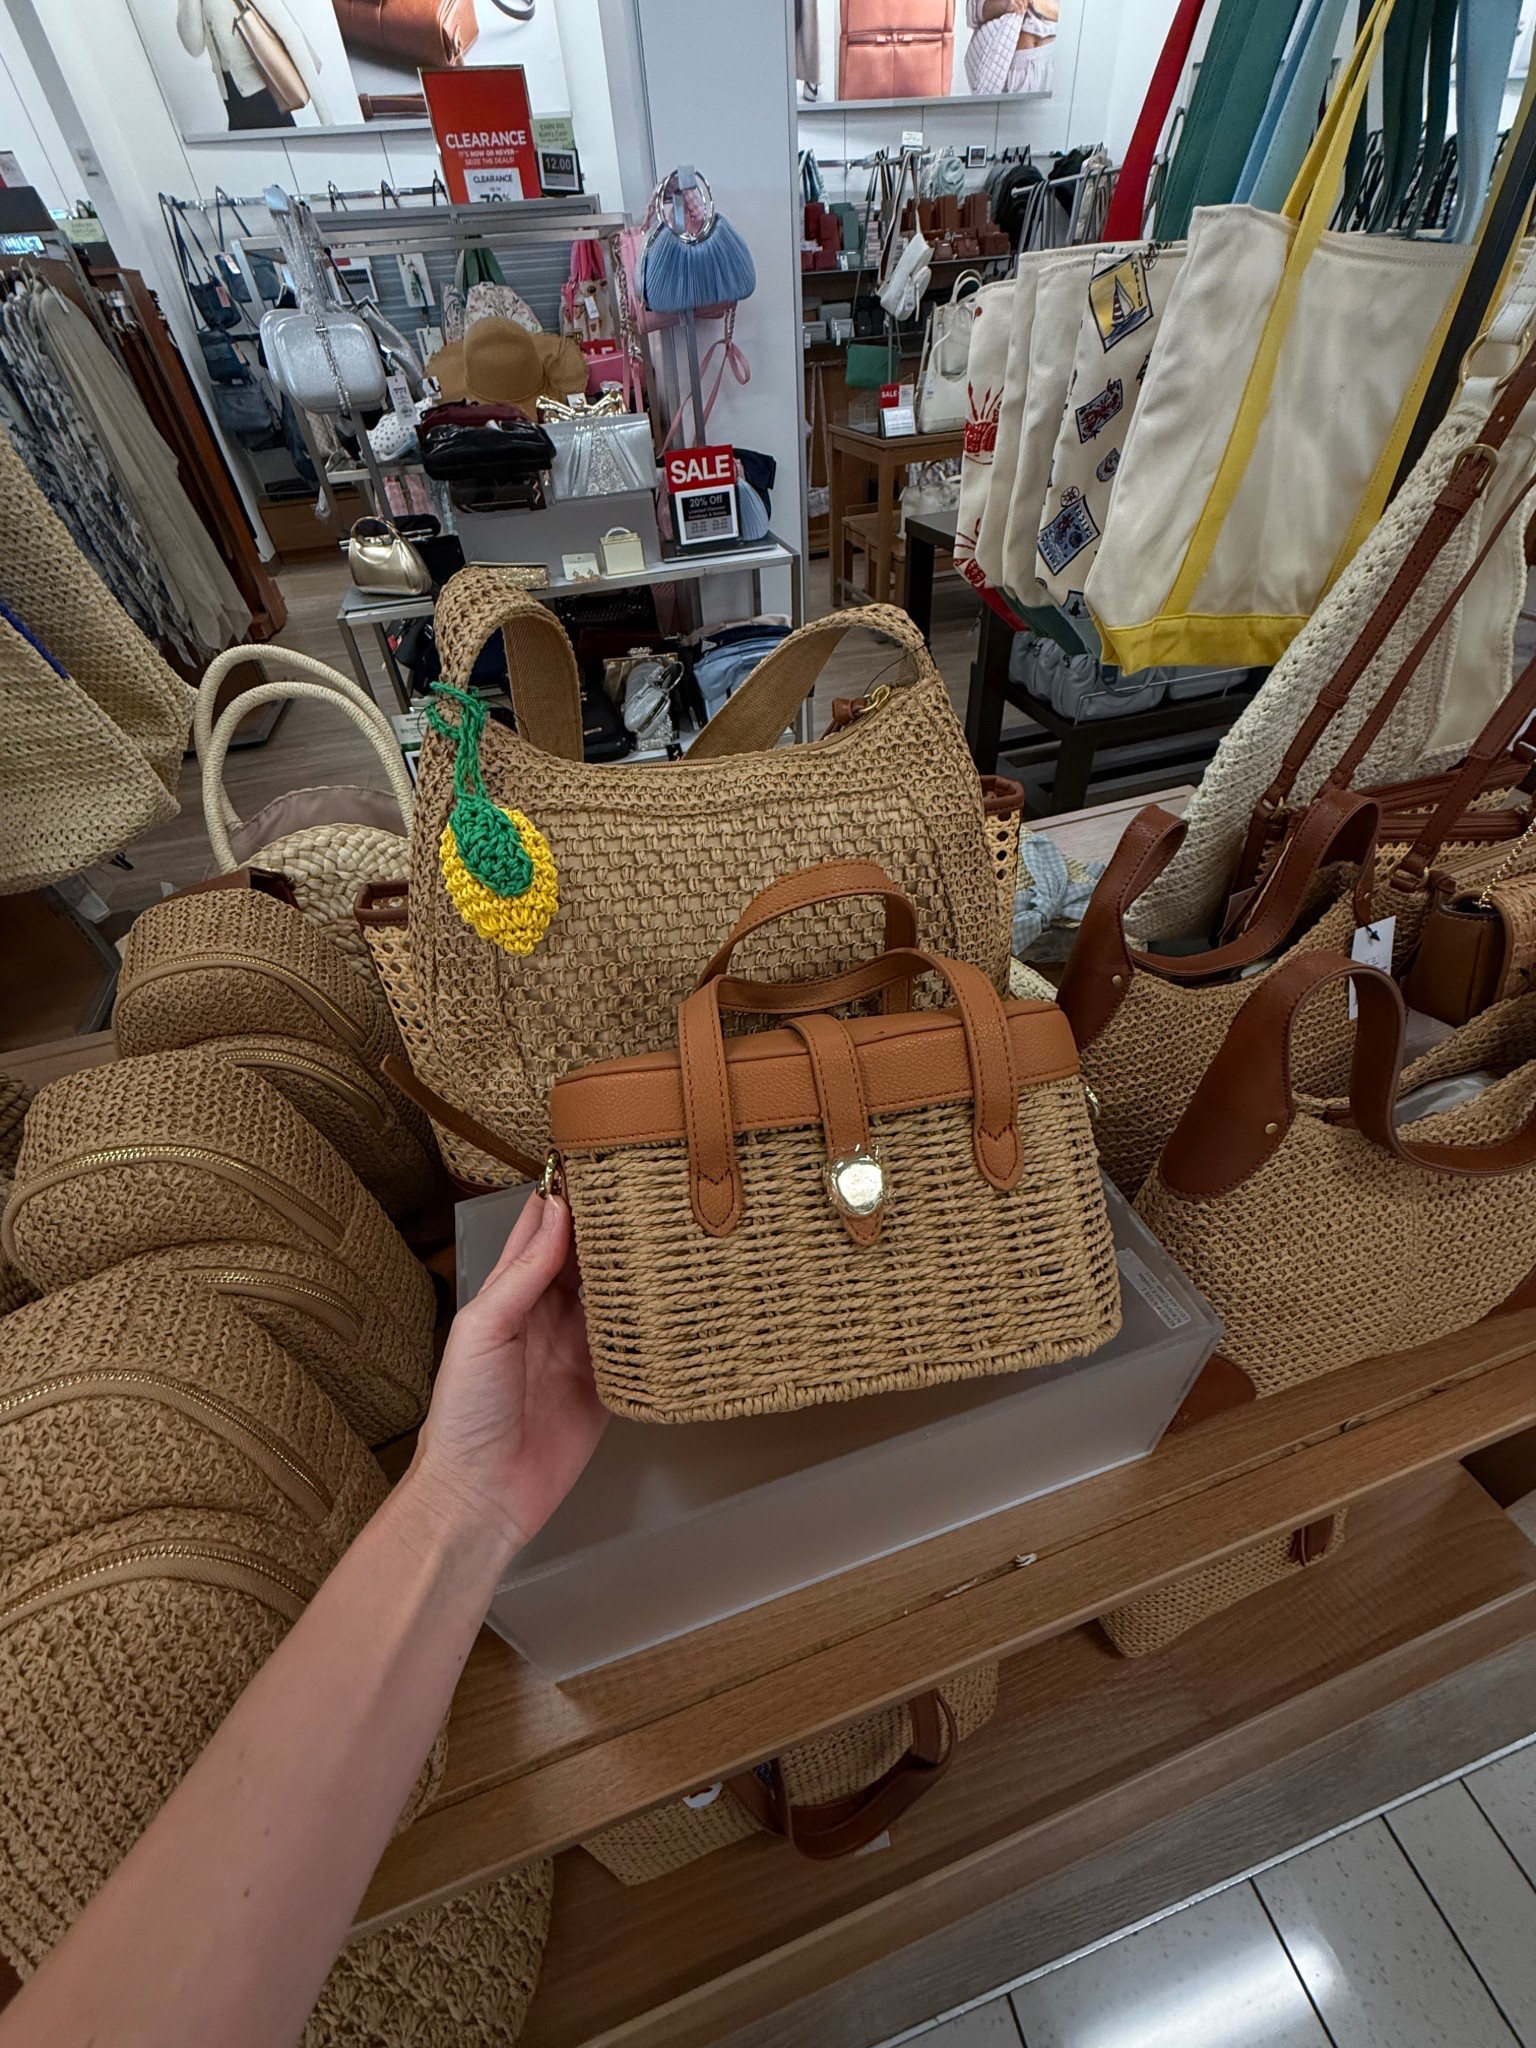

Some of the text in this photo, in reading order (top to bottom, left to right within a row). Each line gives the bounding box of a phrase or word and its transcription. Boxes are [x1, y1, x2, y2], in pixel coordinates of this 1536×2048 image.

[445, 130, 527, 149] CLEARANCE
[470, 149, 485, 157] NOW
[486, 149, 495, 157] OR
[482, 157, 494, 165] THE
[545, 157, 572, 171] 12.00
[473, 174, 513, 184] CLEARANCE
[881, 390, 899, 399] SALE
[670, 454, 731, 485] SALE
[690, 494, 723, 508] 20% Off
